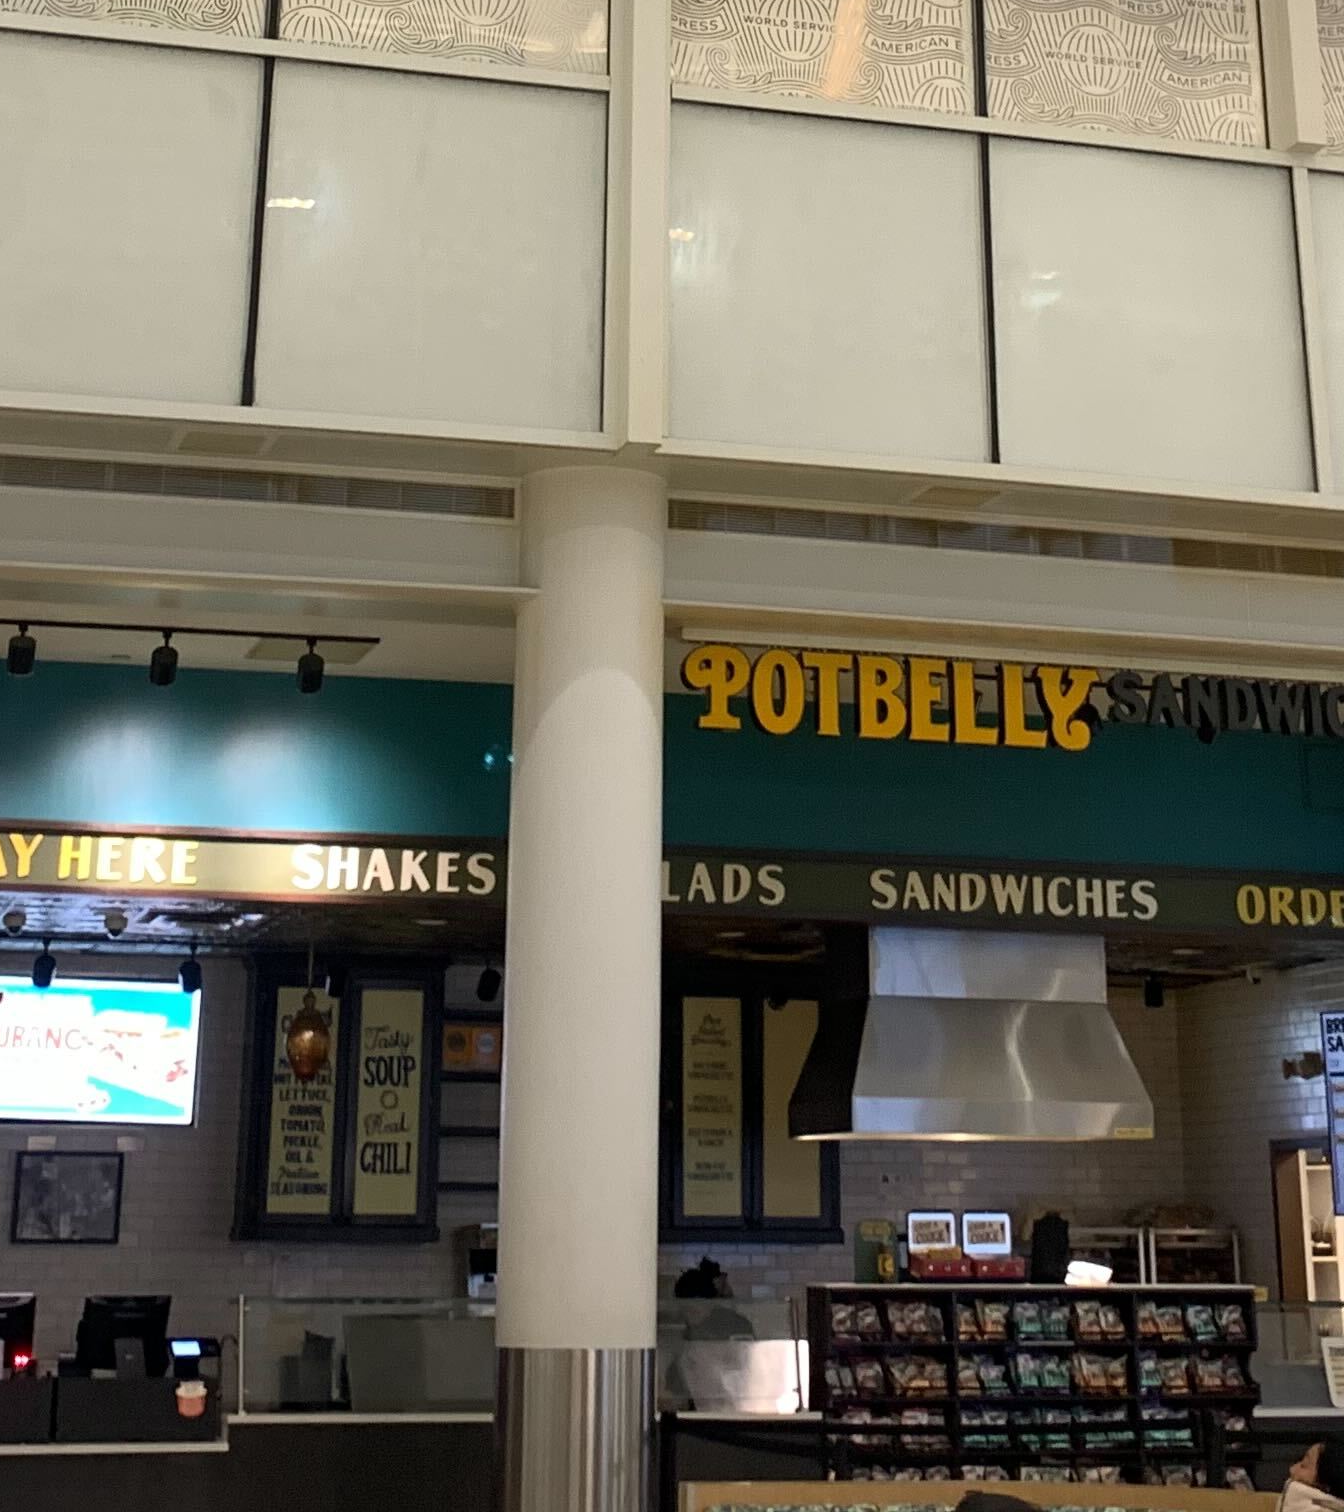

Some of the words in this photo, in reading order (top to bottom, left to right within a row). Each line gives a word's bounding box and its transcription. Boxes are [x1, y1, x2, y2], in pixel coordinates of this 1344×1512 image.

[743, 15, 789, 28] WORLD
[870, 38, 950, 53] AMERICAN
[1045, 50, 1088, 63] WORLD
[1092, 55, 1142, 70] SERVICE
[1167, 72, 1242, 87] AMERICAN
[682, 644, 1103, 752] POTBELLY
[57, 835, 200, 886] HERE
[290, 842, 497, 896] SHAKES
[662, 859, 786, 907] LADS
[869, 868, 1159, 922] SANDWICHES
[364, 1026, 414, 1056] Tasty
[363, 1056, 416, 1087] SOUP
[363, 1112, 410, 1136] Real
[360, 1142, 412, 1175] CHILI
